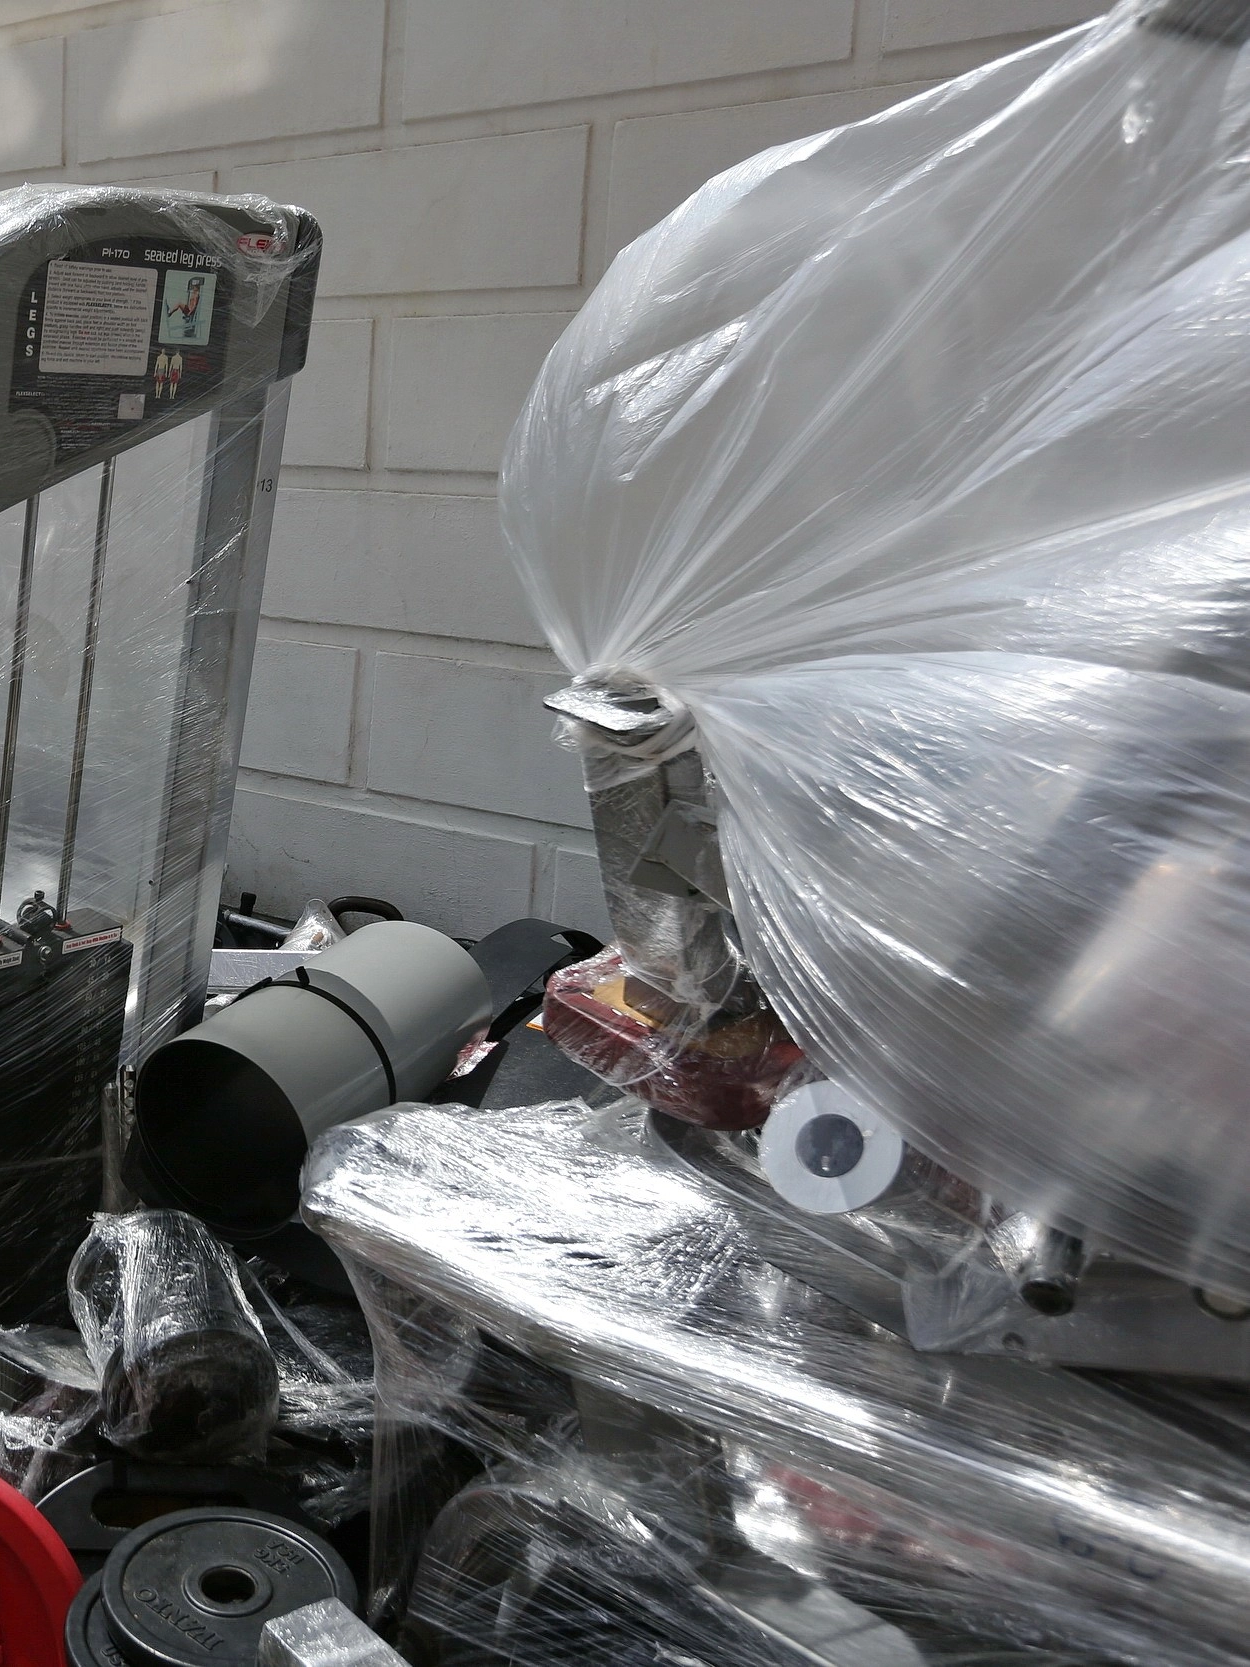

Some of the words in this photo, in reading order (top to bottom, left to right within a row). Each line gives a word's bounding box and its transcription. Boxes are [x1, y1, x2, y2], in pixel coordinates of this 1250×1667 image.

[144, 249, 179, 264] seated
[179, 249, 194, 268] leg
[195, 254, 223, 269] press
[25, 291, 38, 357] LEGS
[260, 478, 273, 493] 13
